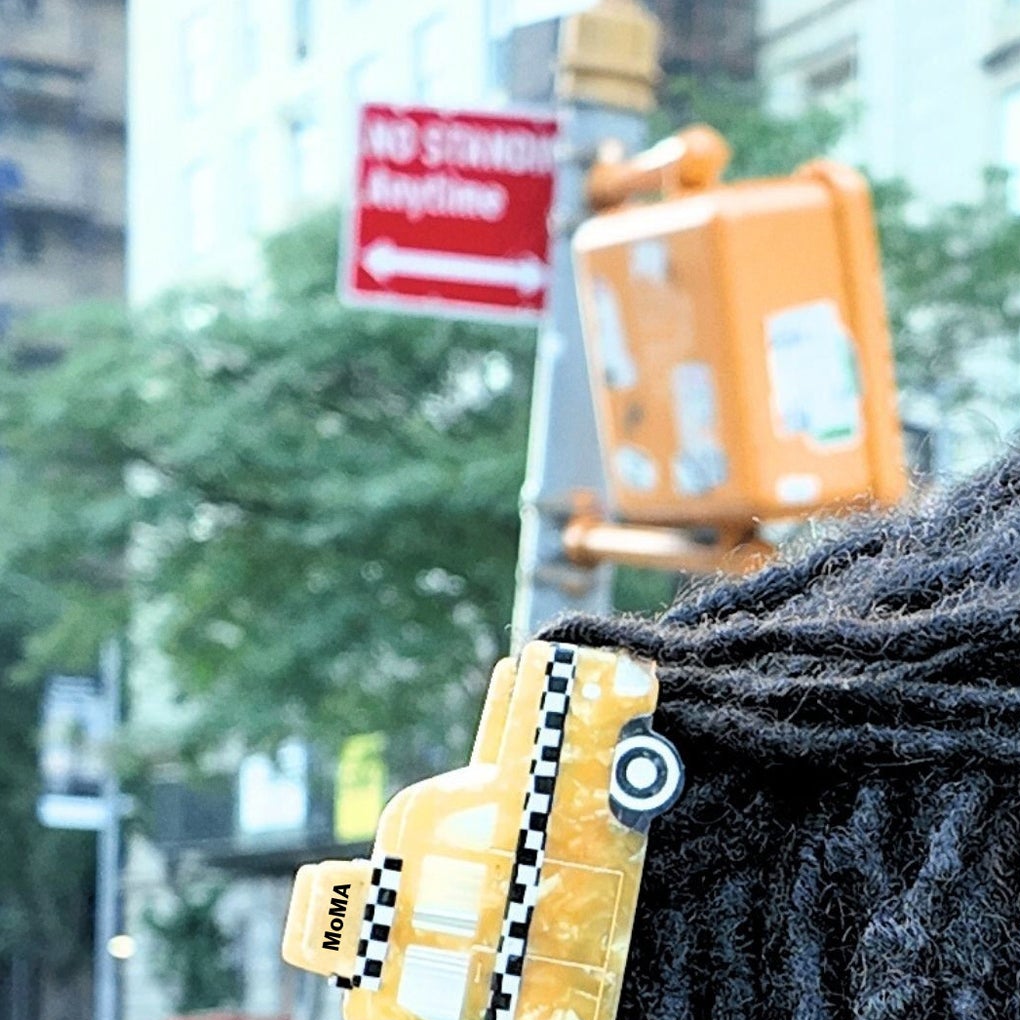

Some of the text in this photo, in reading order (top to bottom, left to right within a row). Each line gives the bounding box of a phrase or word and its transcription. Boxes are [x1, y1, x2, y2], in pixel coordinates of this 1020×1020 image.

[366, 118, 419, 166] NO
[367, 168, 508, 222] Anytime
[322, 883, 351, 951] MoMA
